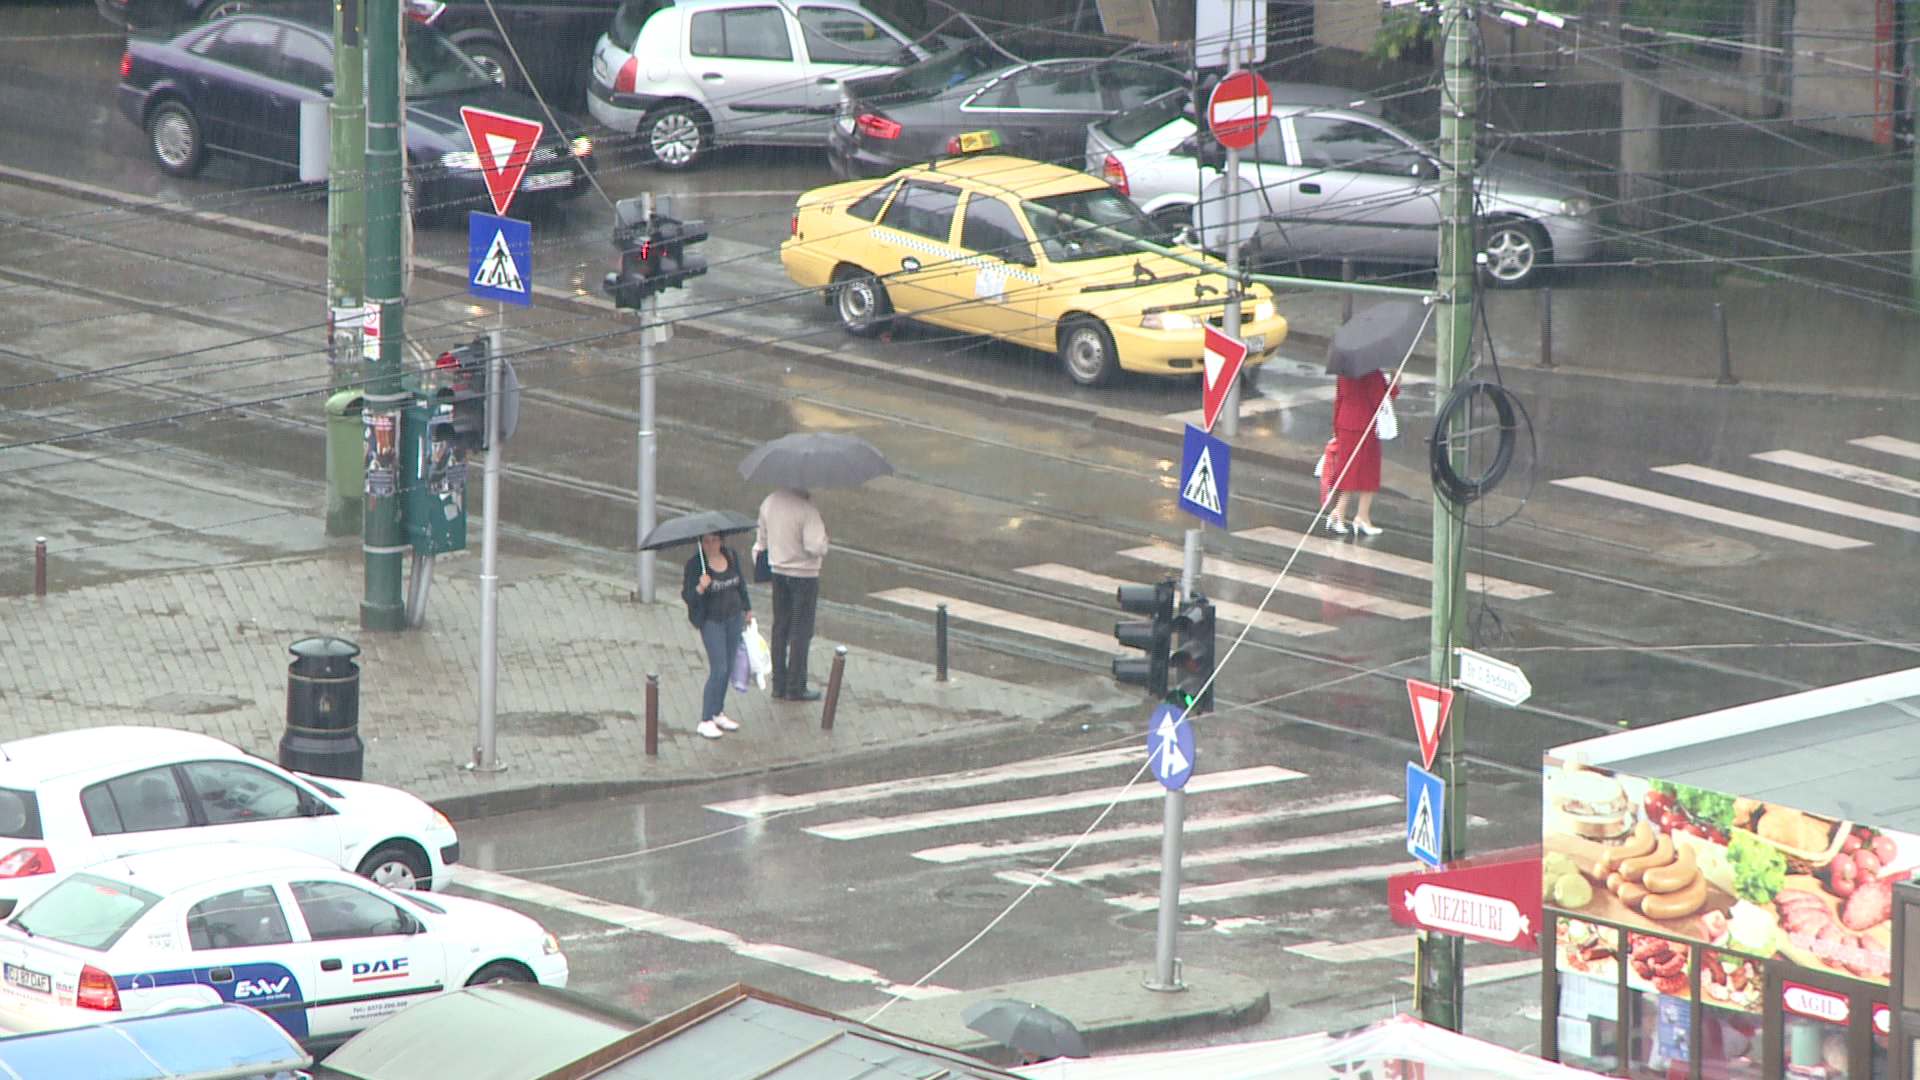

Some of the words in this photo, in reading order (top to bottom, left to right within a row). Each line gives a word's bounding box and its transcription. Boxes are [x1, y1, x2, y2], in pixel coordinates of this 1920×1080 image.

[1430, 892, 1503, 932] MEZELURI
[352, 957, 409, 976] DAF
[1796, 994, 1838, 1017] AGIL
